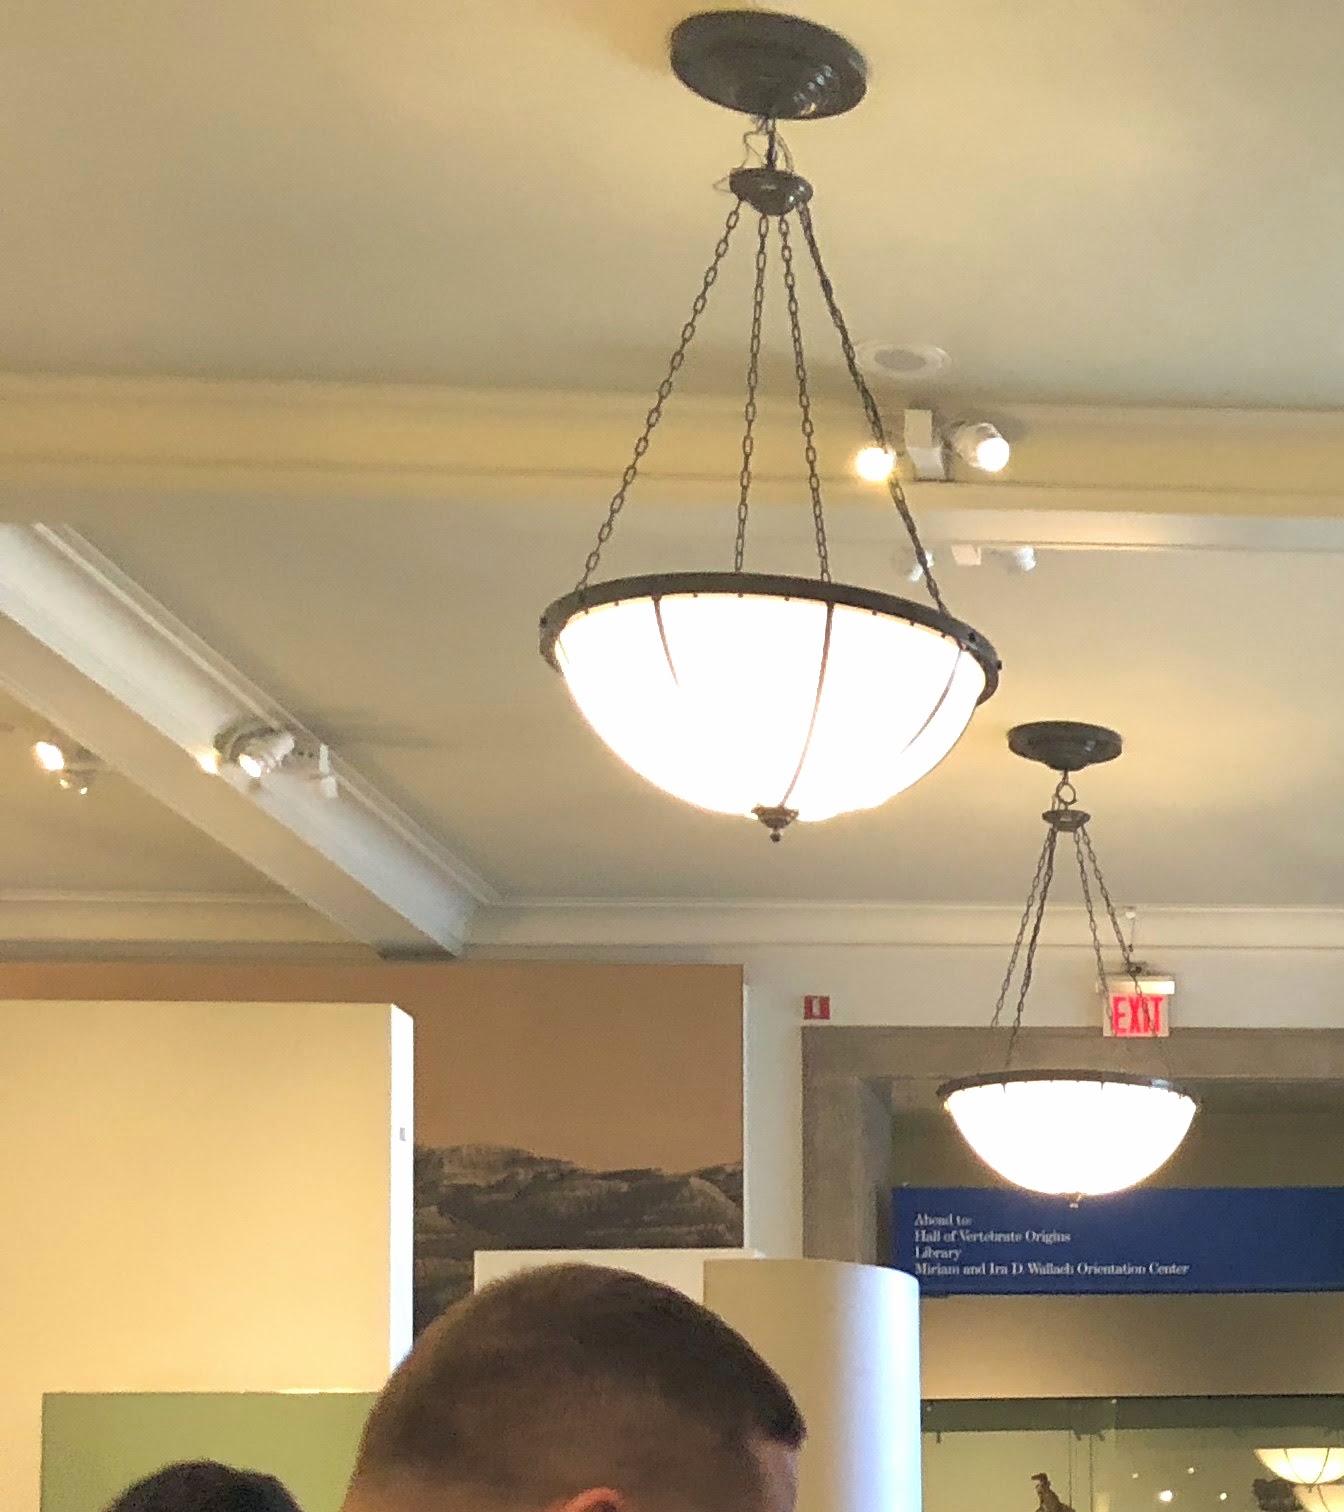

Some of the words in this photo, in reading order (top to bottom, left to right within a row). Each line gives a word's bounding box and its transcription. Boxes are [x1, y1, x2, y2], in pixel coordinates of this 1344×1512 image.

[1112, 996, 1163, 1033] EXIT
[914, 1213, 953, 1226] Ahead
[914, 1230, 941, 1242] Hall
[943, 1230, 957, 1242] of
[960, 1230, 1022, 1242] Vertebrate
[1025, 1230, 1071, 1245] Origins
[915, 1246, 961, 1261] Library
[915, 1262, 960, 1275] Miriam
[963, 1262, 986, 1275] and
[989, 1262, 1008, 1275] Ira
[1077, 1262, 1146, 1275] Orientation
[1149, 1262, 1190, 1275] Center
